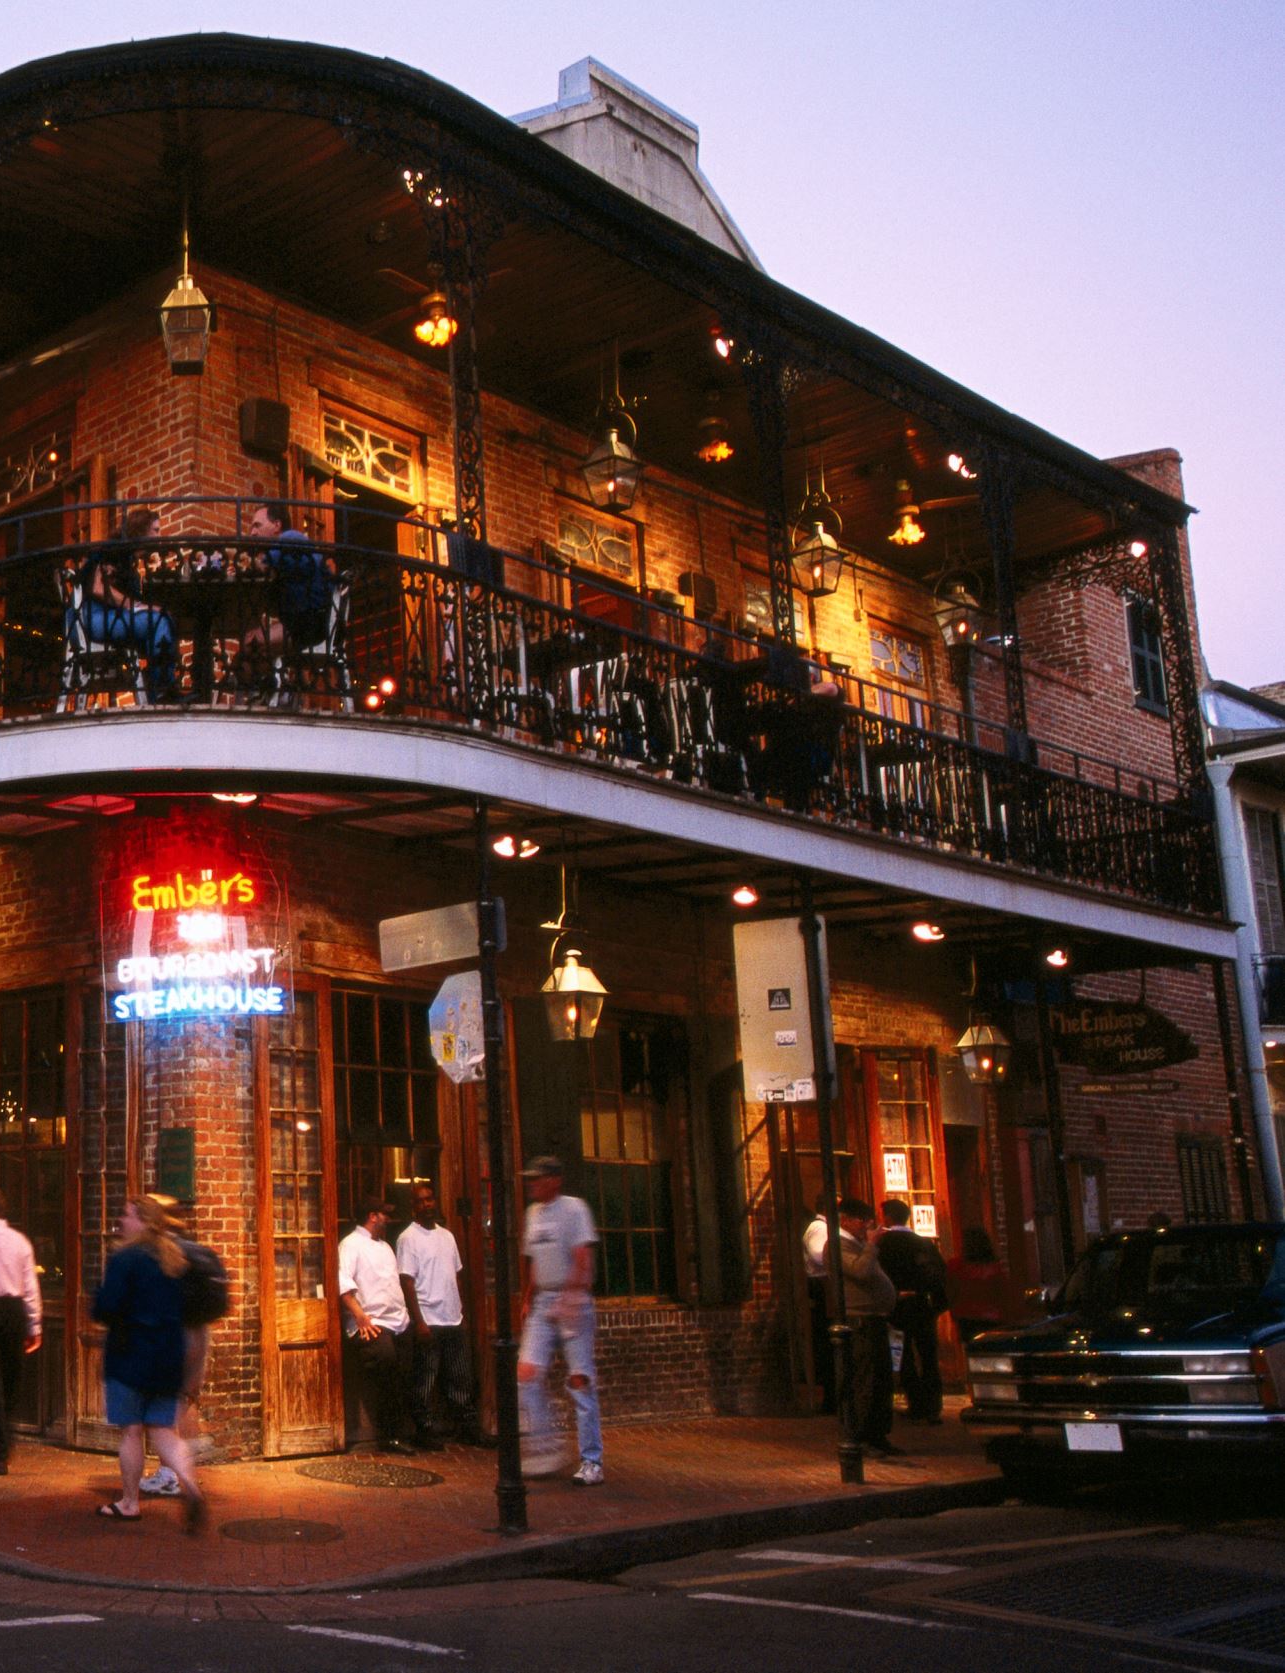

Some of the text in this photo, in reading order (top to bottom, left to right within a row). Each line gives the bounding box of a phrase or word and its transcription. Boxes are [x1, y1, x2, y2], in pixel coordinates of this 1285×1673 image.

[114, 986, 284, 1019] STEAKHOUSE
[1081, 1008, 1147, 1033] Embers
[1083, 1034, 1135, 1049] STEAK
[1119, 1047, 1165, 1063] HOUSE
[887, 1158, 905, 1175] ATM
[916, 1209, 934, 1225] ATM
